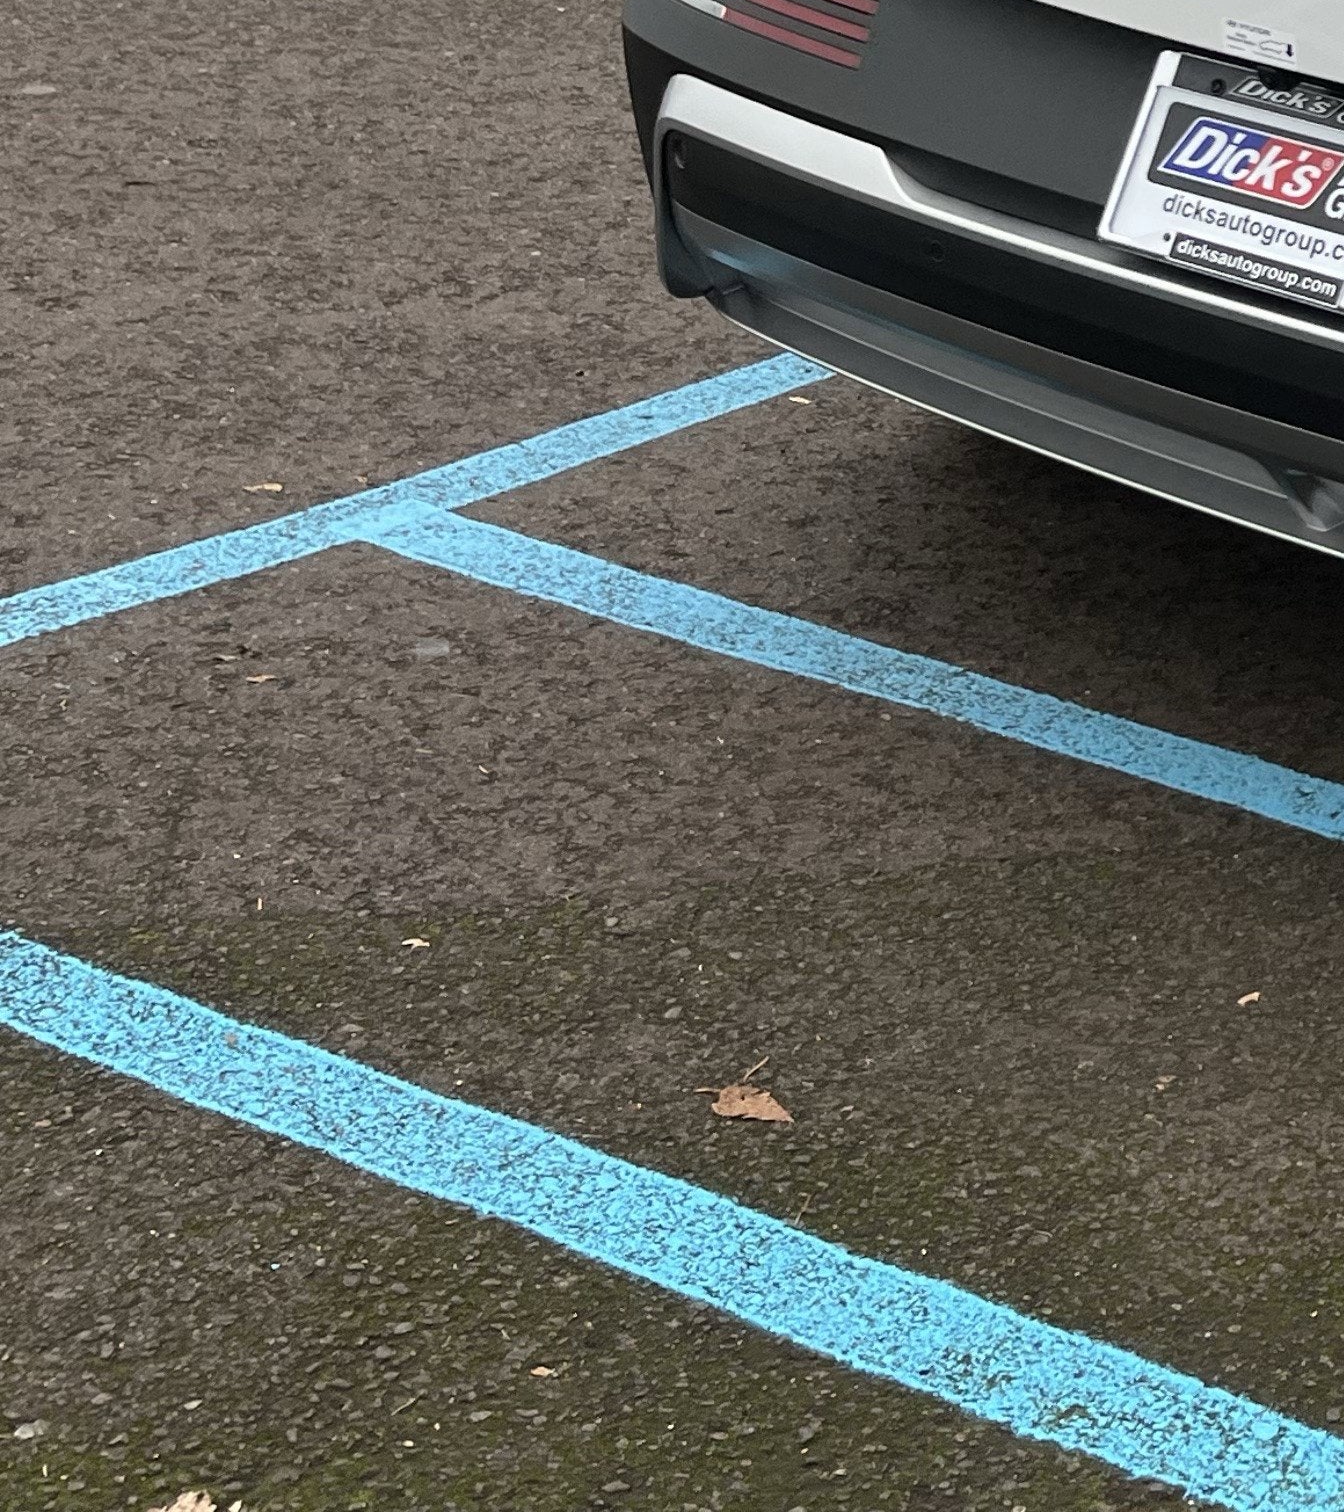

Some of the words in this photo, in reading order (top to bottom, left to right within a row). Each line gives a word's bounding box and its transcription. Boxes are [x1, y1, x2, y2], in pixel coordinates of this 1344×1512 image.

[1238, 80, 1332, 115] Dick's
[1172, 126, 1323, 199] Dick's
[1175, 239, 1337, 298] dicksautogroup.com
